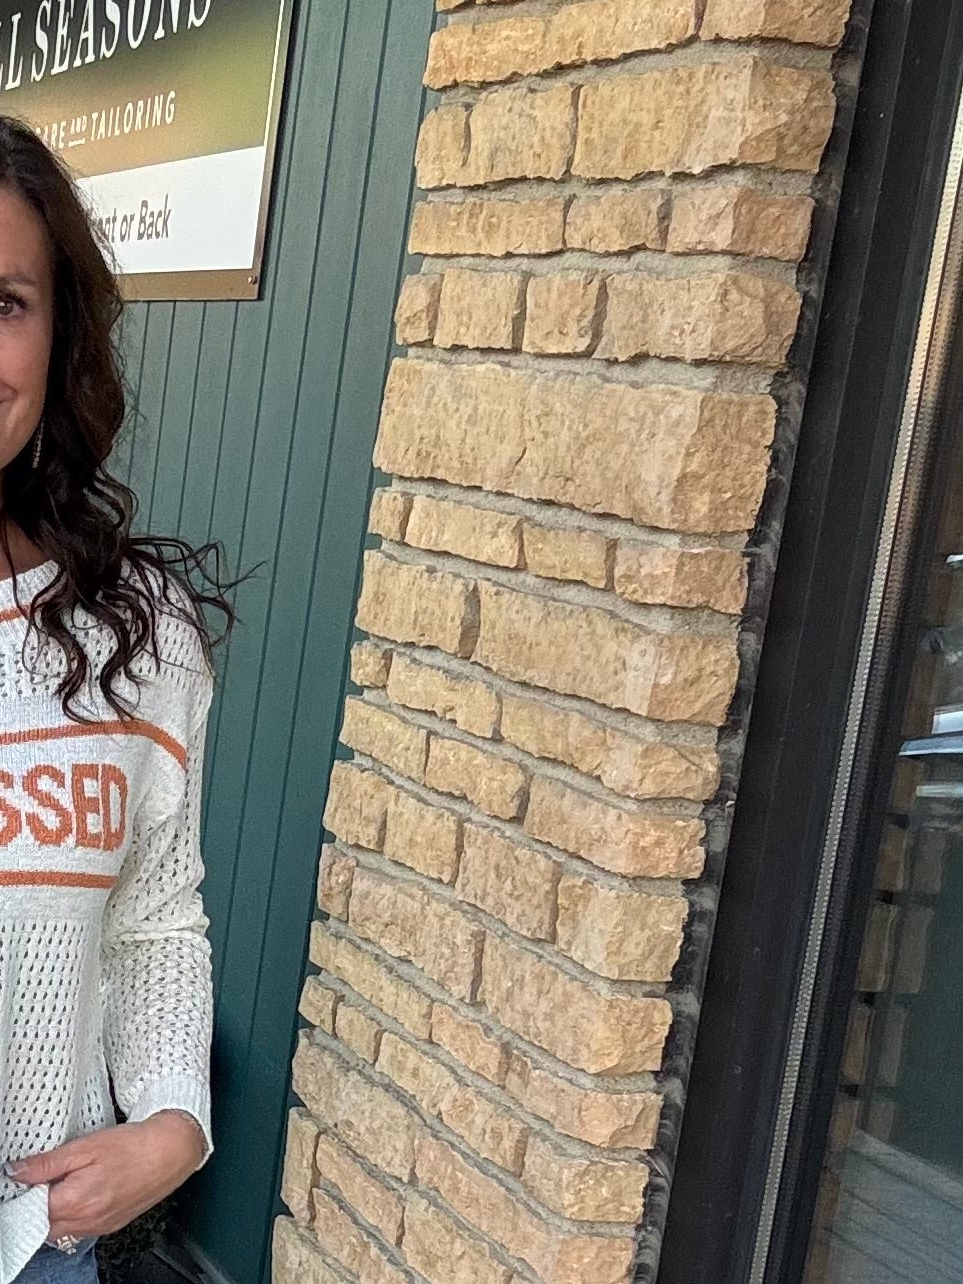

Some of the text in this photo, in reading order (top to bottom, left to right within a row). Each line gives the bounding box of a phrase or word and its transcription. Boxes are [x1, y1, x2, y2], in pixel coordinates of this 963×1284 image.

[70, 115, 87, 135] AND
[90, 90, 176, 142] TAILORING
[119, 212, 135, 243] or
[136, 192, 173, 241] Back
